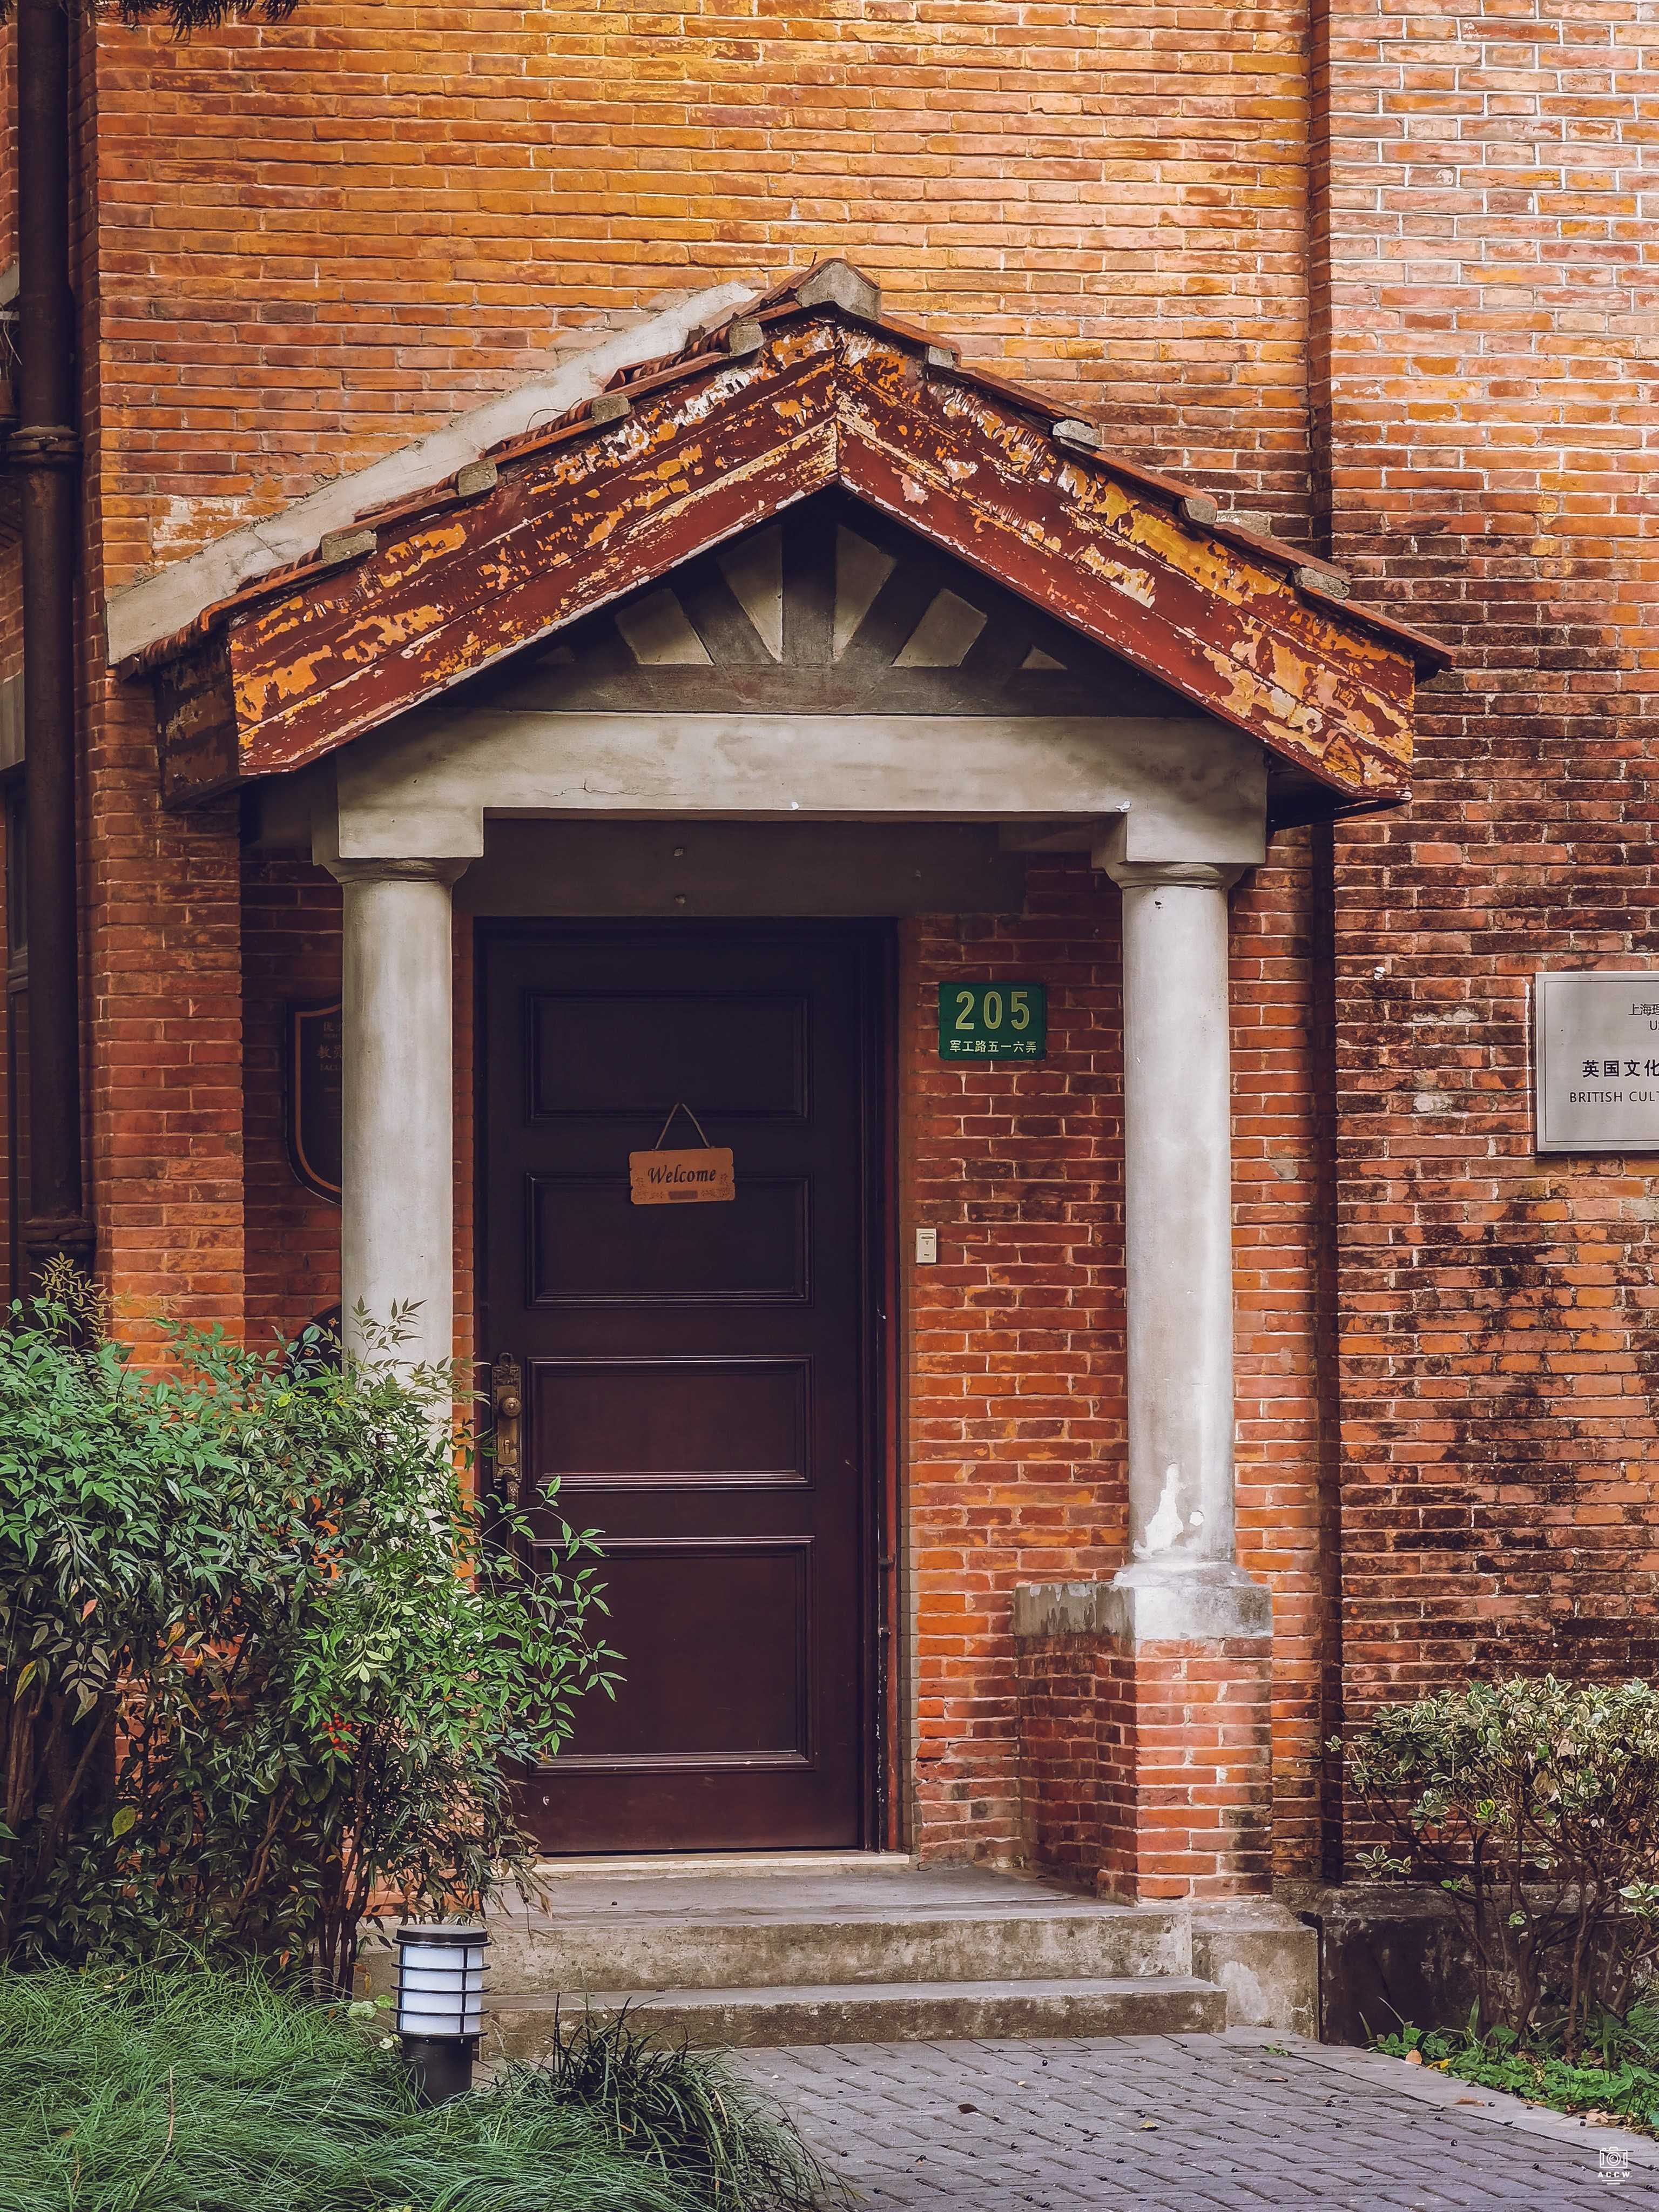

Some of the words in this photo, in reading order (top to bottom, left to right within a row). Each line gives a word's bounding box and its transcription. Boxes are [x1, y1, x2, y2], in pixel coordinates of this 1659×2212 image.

[955, 990, 1030, 1030] 205
[1649, 1020, 1659, 1031] U
[949, 1040, 1037, 1053] 军工路五一六弄
[1582, 1059, 1659, 1078] 英国文化
[1569, 1091, 1622, 1103] BRITISH
[648, 1164, 716, 1184] Welcome
